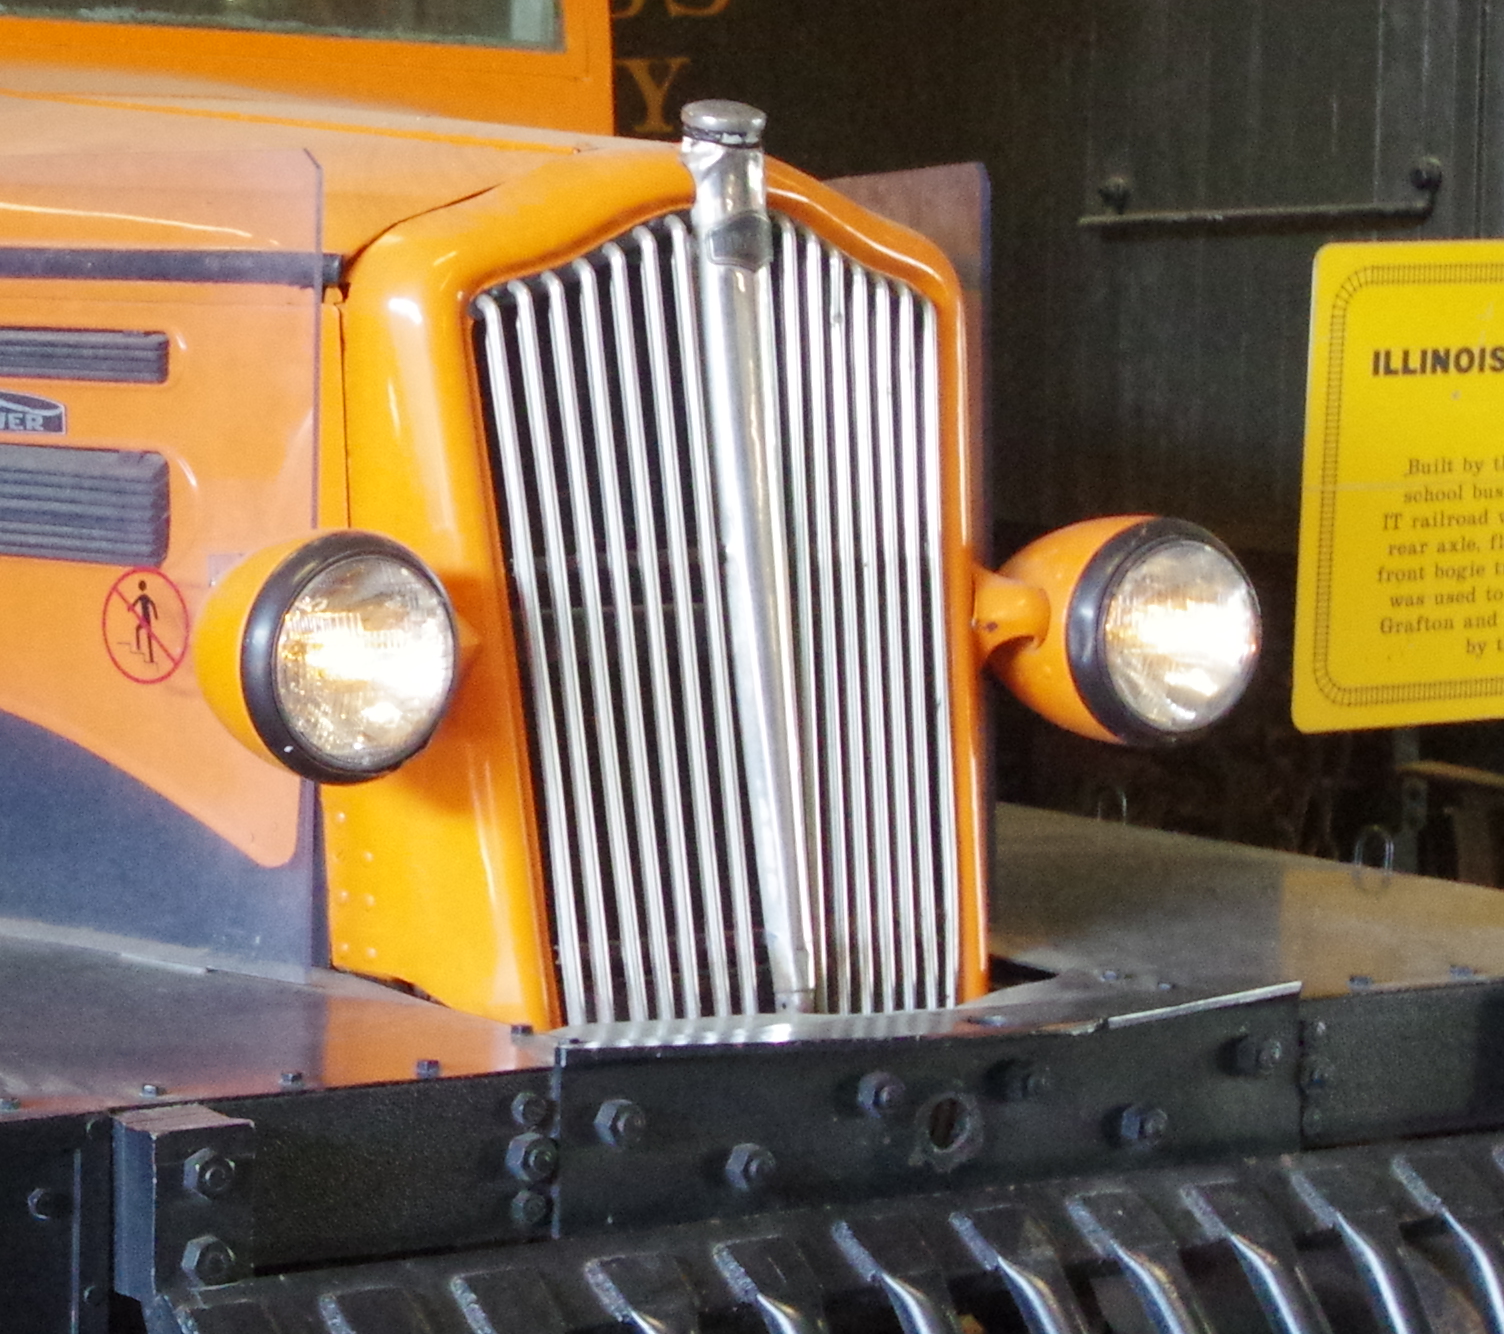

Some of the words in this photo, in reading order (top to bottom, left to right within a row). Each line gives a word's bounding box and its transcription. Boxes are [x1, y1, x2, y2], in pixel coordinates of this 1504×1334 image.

[1408, 457, 1453, 476] Built
[1463, 457, 1484, 476] by
[1403, 484, 1462, 504] school
[1383, 512, 1402, 531] IT
[1412, 508, 1488, 529] railroad
[1388, 540, 1428, 557] rear
[1436, 536, 1480, 555] axle,
[1377, 565, 1425, 584] front
[1434, 562, 1485, 583] bogie
[1390, 593, 1425, 609] was
[1434, 586, 1476, 606] used
[1486, 585, 1503, 602] to
[1379, 615, 1455, 635] Grafton
[1463, 610, 1497, 630] and
[1465, 638, 1487, 658] by
